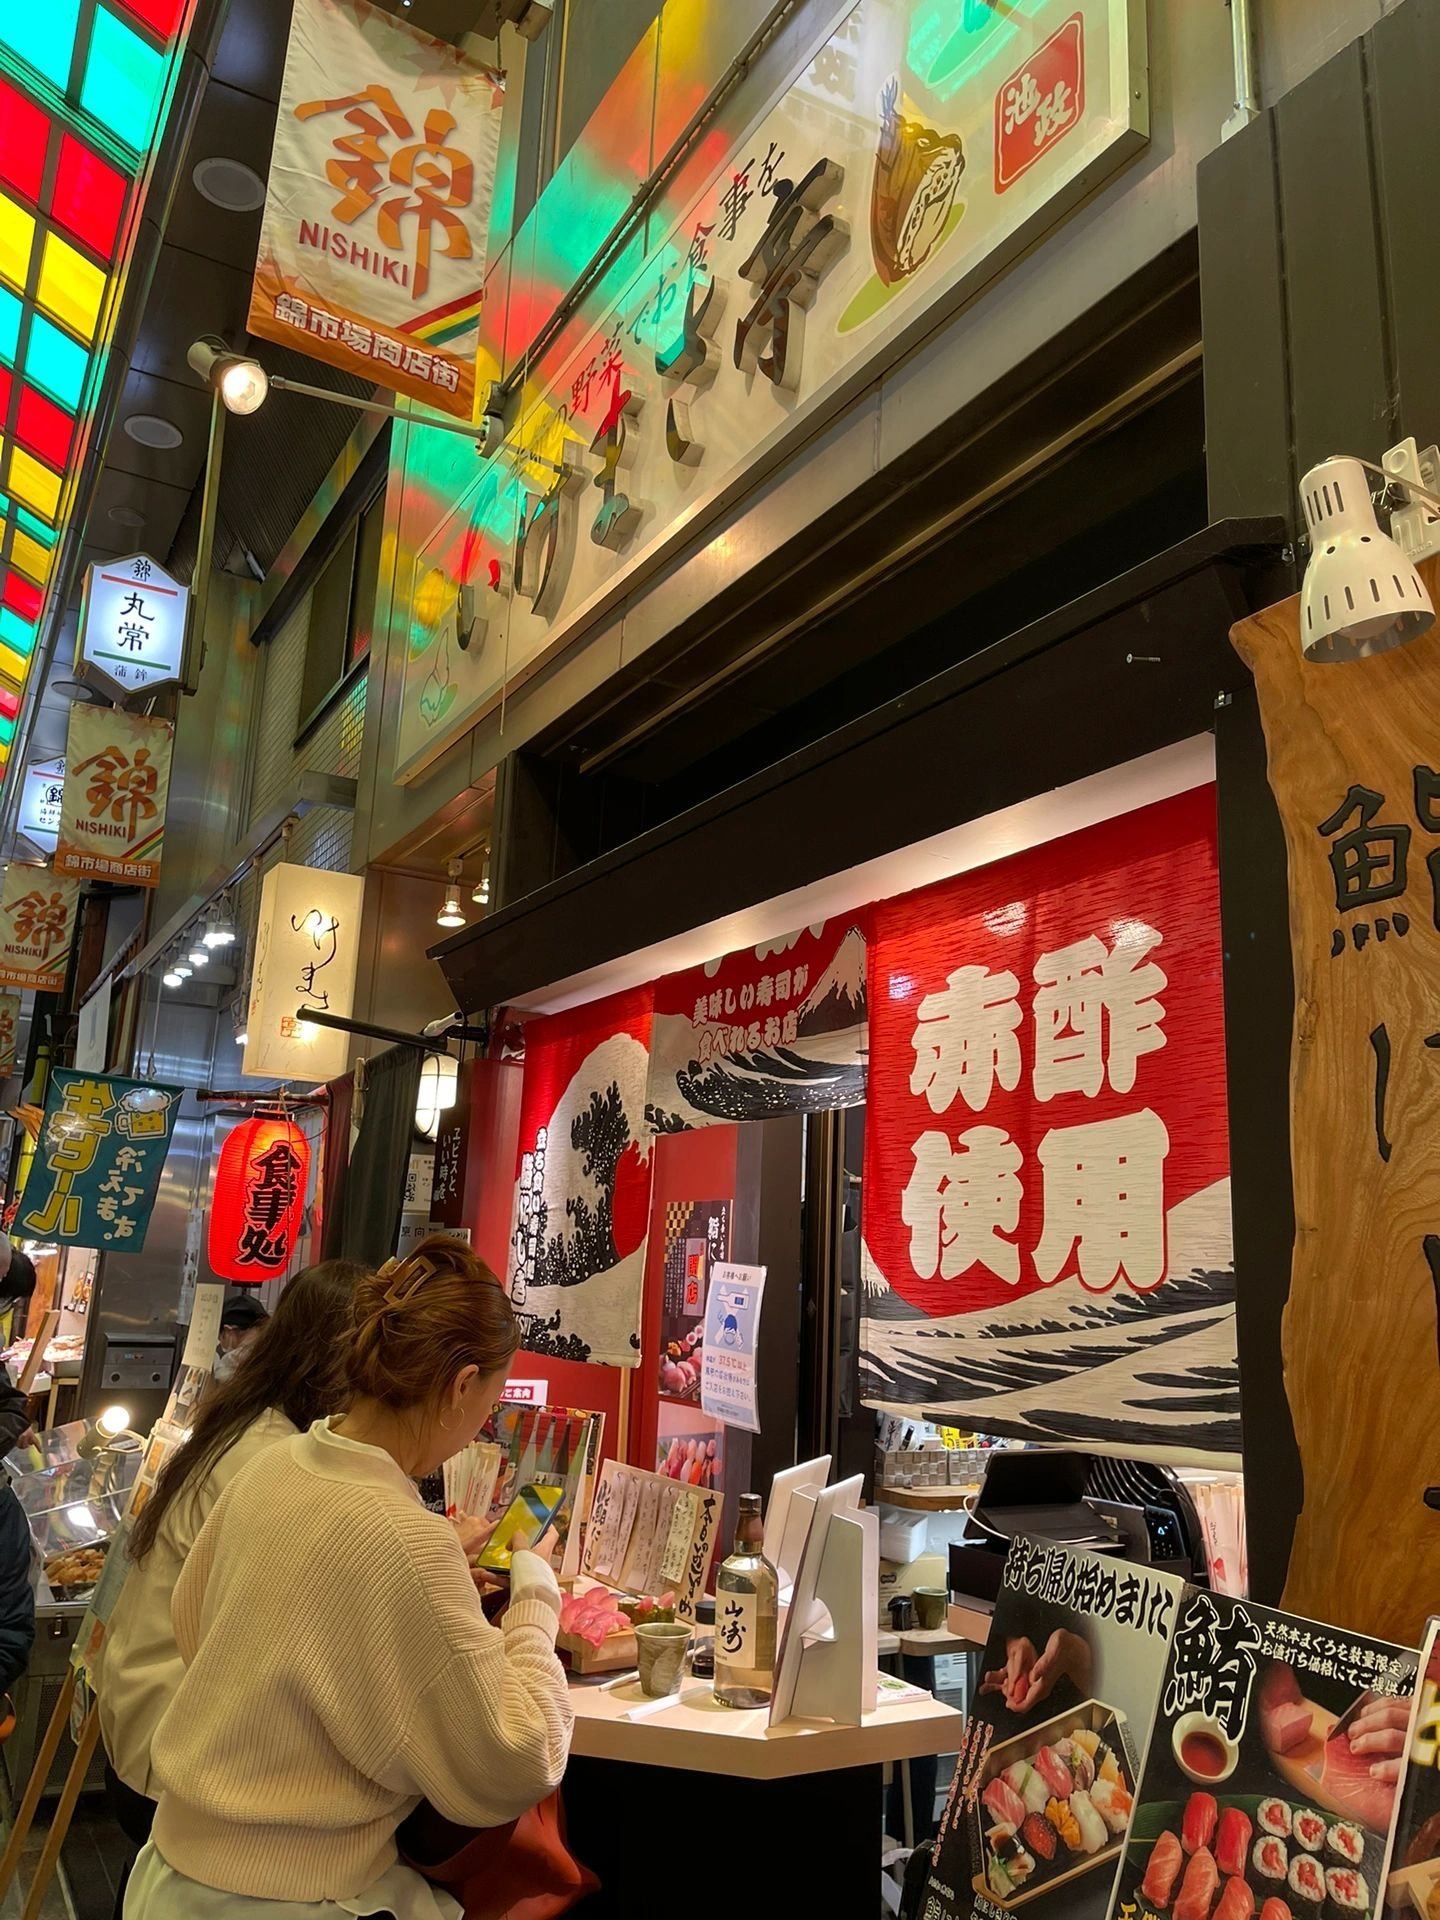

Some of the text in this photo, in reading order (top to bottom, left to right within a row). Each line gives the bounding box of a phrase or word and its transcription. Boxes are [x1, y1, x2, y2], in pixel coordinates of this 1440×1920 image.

[294, 84, 473, 299] 錦
[298, 219, 410, 287] NISHIKI
[274, 291, 461, 394] 錦市場商店街
[117, 592, 155, 651] 丸常
[72, 746, 158, 843] 錦
[76, 819, 127, 838] NISHIKI
[65, 854, 152, 878] 錦市場商店街
[4, 891, 68, 960] 錦
[5, 943, 42, 958] NISHIKI
[693, 964, 809, 1028] 美味しい寿司が
[698, 1009, 799, 1064] 食べれるお店
[909, 928, 1169, 1114] 赤酢
[23, 1079, 115, 1236] 生ビール
[234, 1142, 302, 1267] 食事処
[901, 1107, 1170, 1294] 使用
[721, 1600, 747, 1653] 山崎
[1003, 1536, 1174, 1641] 持ち帰り始めました
[1164, 1594, 1262, 1746] 鮪
